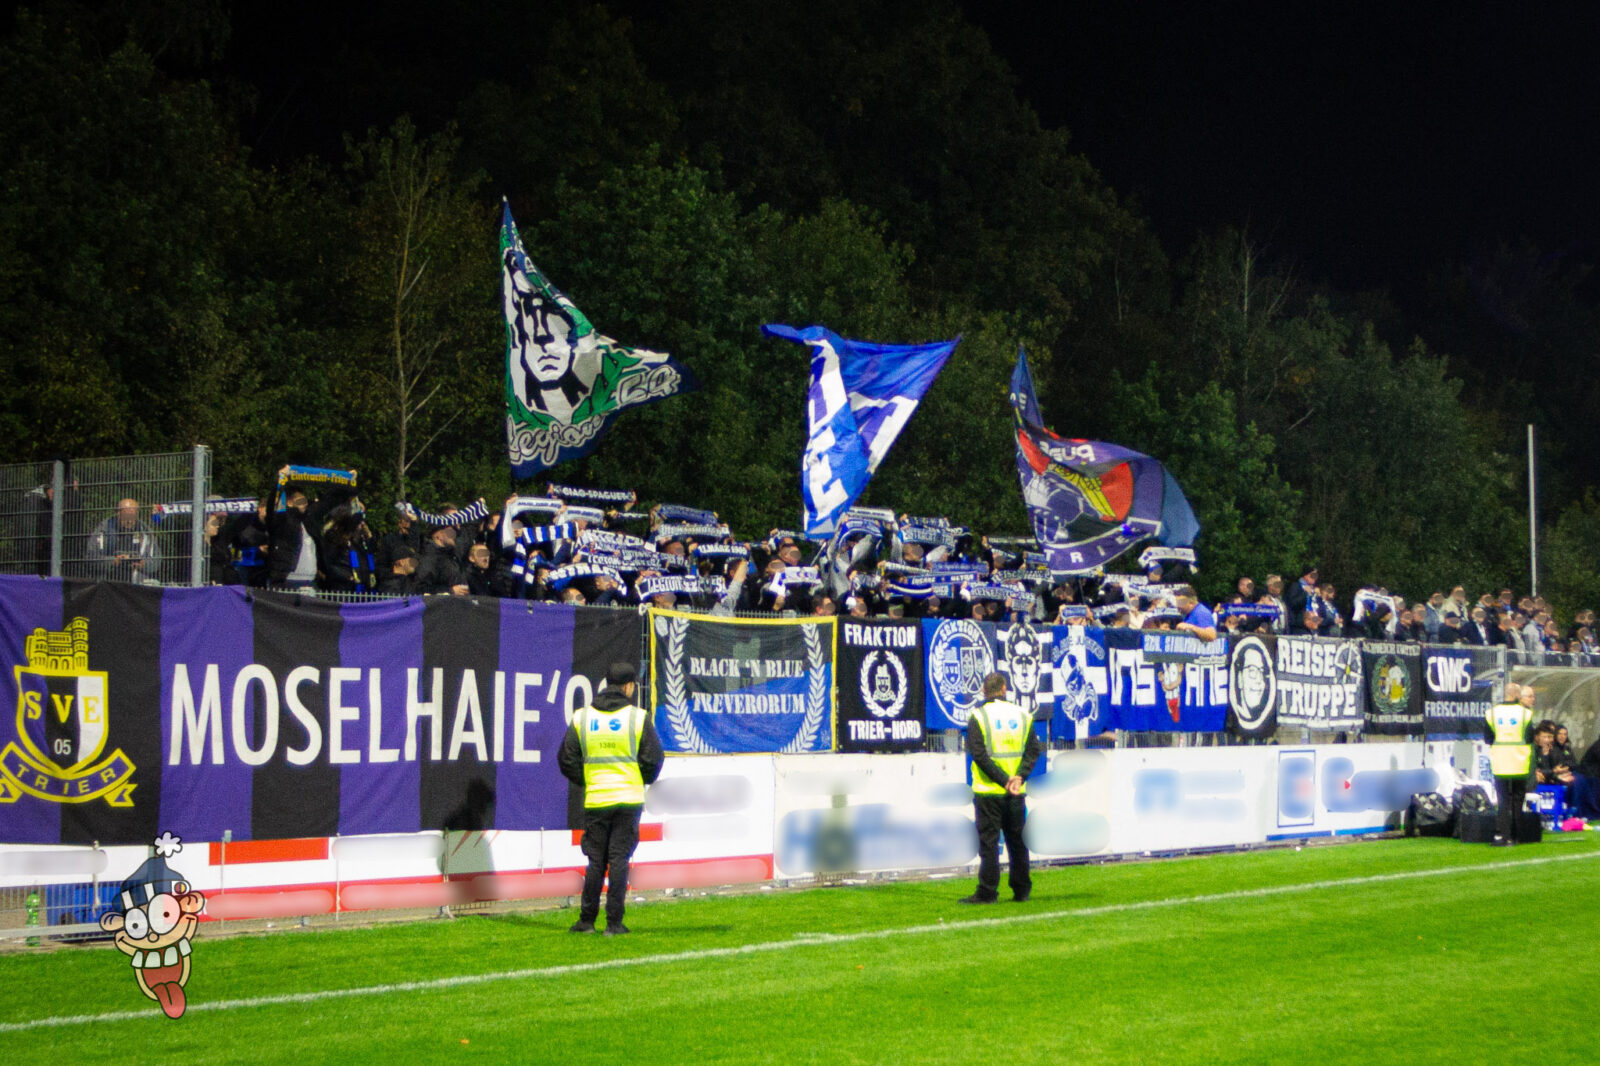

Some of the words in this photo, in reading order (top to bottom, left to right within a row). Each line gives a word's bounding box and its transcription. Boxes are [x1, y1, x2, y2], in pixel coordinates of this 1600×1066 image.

[844, 623, 916, 647] FRAKTION
[690, 657, 740, 677] BLACK
[763, 660, 804, 678] BLUE
[1277, 638, 1337, 678] REISE
[691, 691, 805, 714] TREVERORUM
[1277, 679, 1358, 717] TRUPPE
[169, 663, 607, 767] MOSELHAIE'0
[848, 720, 921, 741] TRIER-NORD
[54, 738, 72, 755] 05
[17, 764, 117, 795] TRIER
